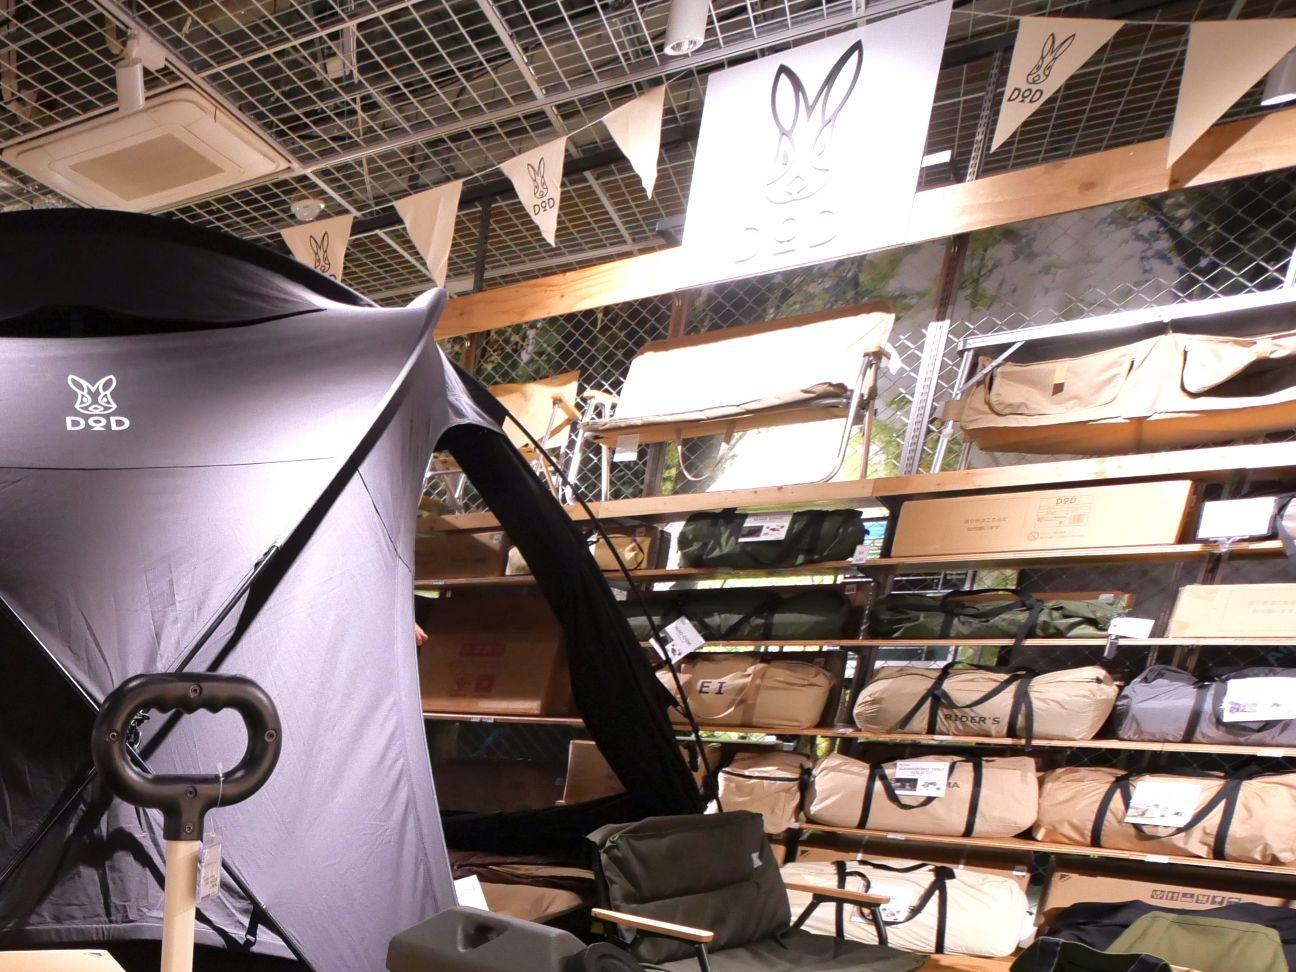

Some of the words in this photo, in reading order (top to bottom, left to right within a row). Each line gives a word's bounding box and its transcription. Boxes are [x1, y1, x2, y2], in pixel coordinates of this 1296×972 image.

[1007, 87, 1043, 104] DOD
[533, 197, 555, 216] DOD
[65, 415, 131, 431] DOD
[698, 680, 727, 695] EI
[944, 713, 1002, 725] RIDER'S
